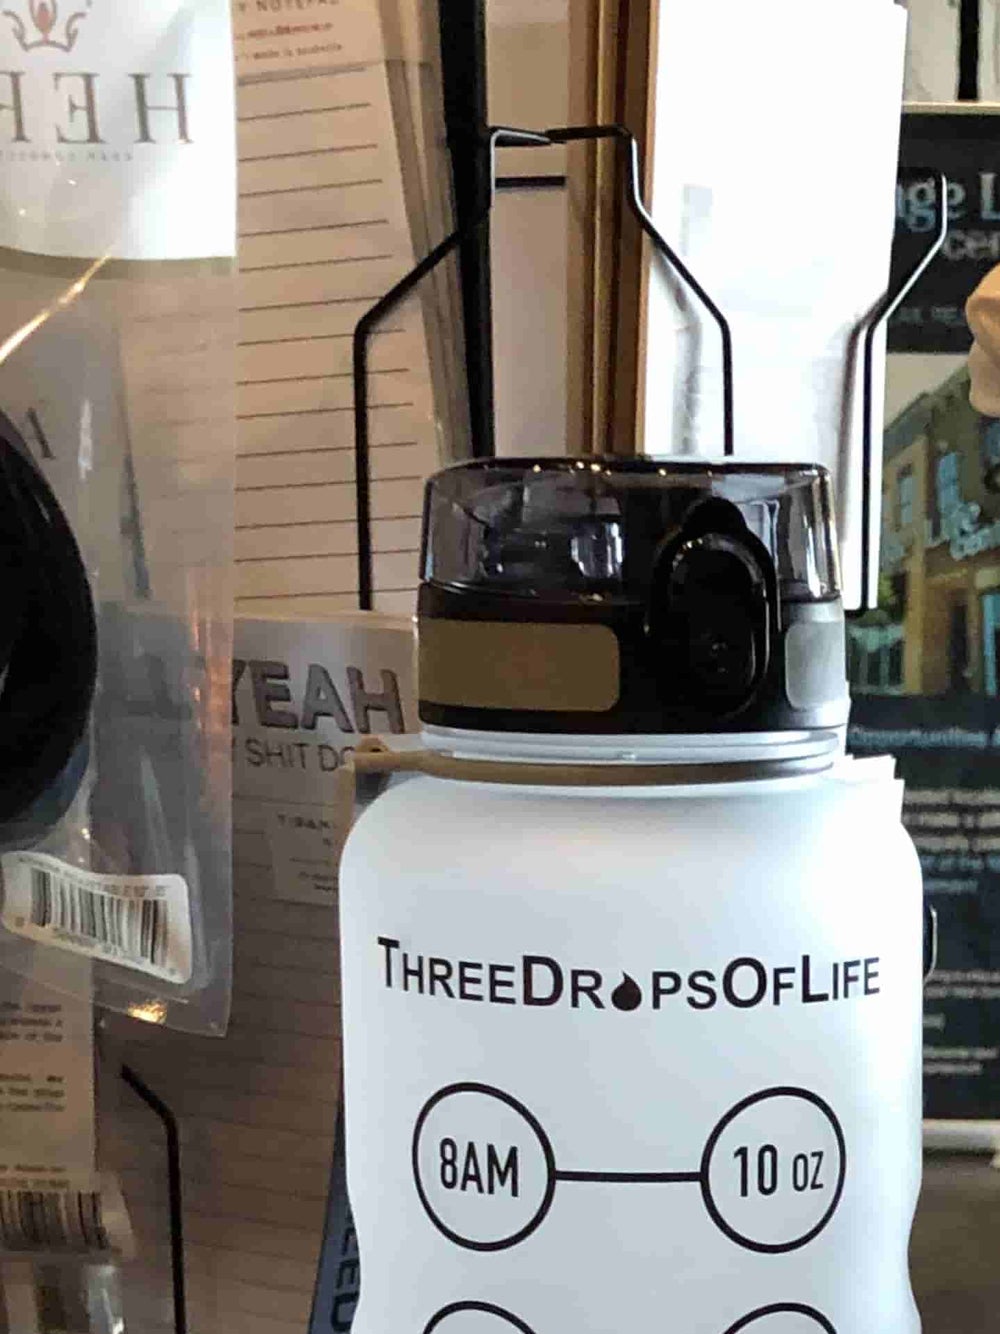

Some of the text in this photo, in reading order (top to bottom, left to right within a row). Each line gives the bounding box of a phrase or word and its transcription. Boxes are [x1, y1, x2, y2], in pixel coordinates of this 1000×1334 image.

[245, 739, 310, 769] SHIT
[439, 1137, 519, 1198] 8AM
[733, 1144, 778, 1197] 10
